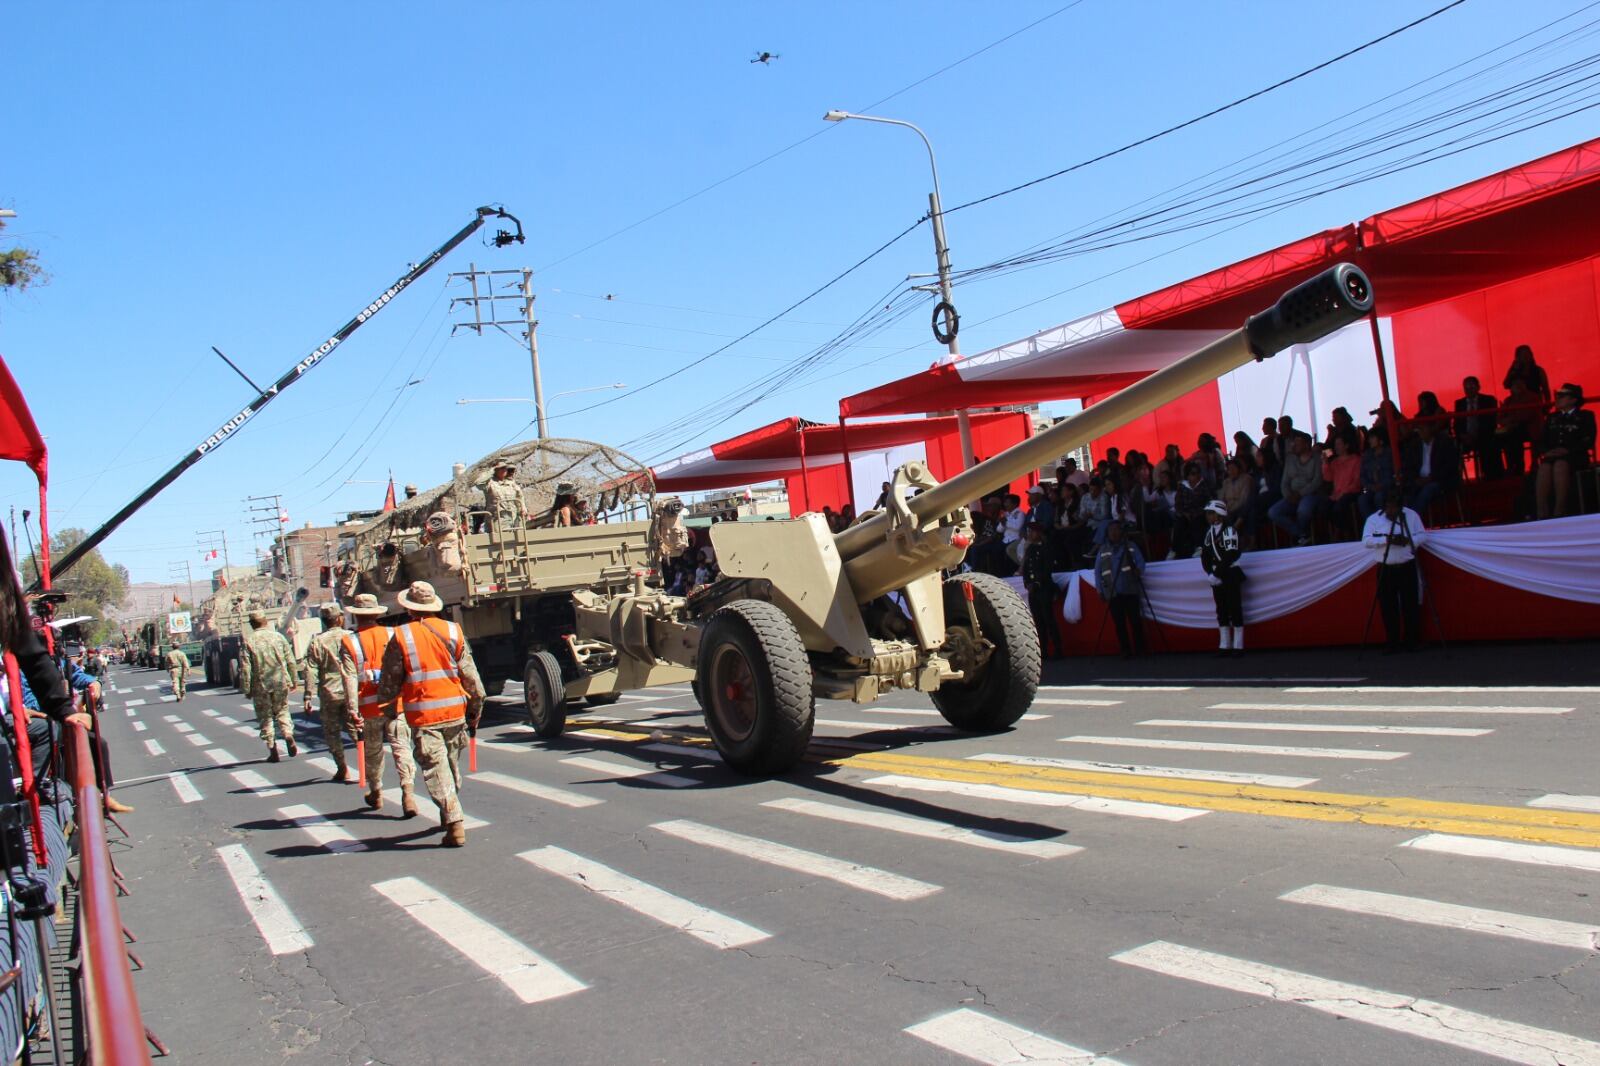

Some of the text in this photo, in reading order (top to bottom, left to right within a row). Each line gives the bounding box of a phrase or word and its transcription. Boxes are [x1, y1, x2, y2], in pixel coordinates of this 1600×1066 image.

[197, 406, 254, 454] PRENDE
[268, 383, 279, 394] Y
[297, 336, 340, 374] APAGA
